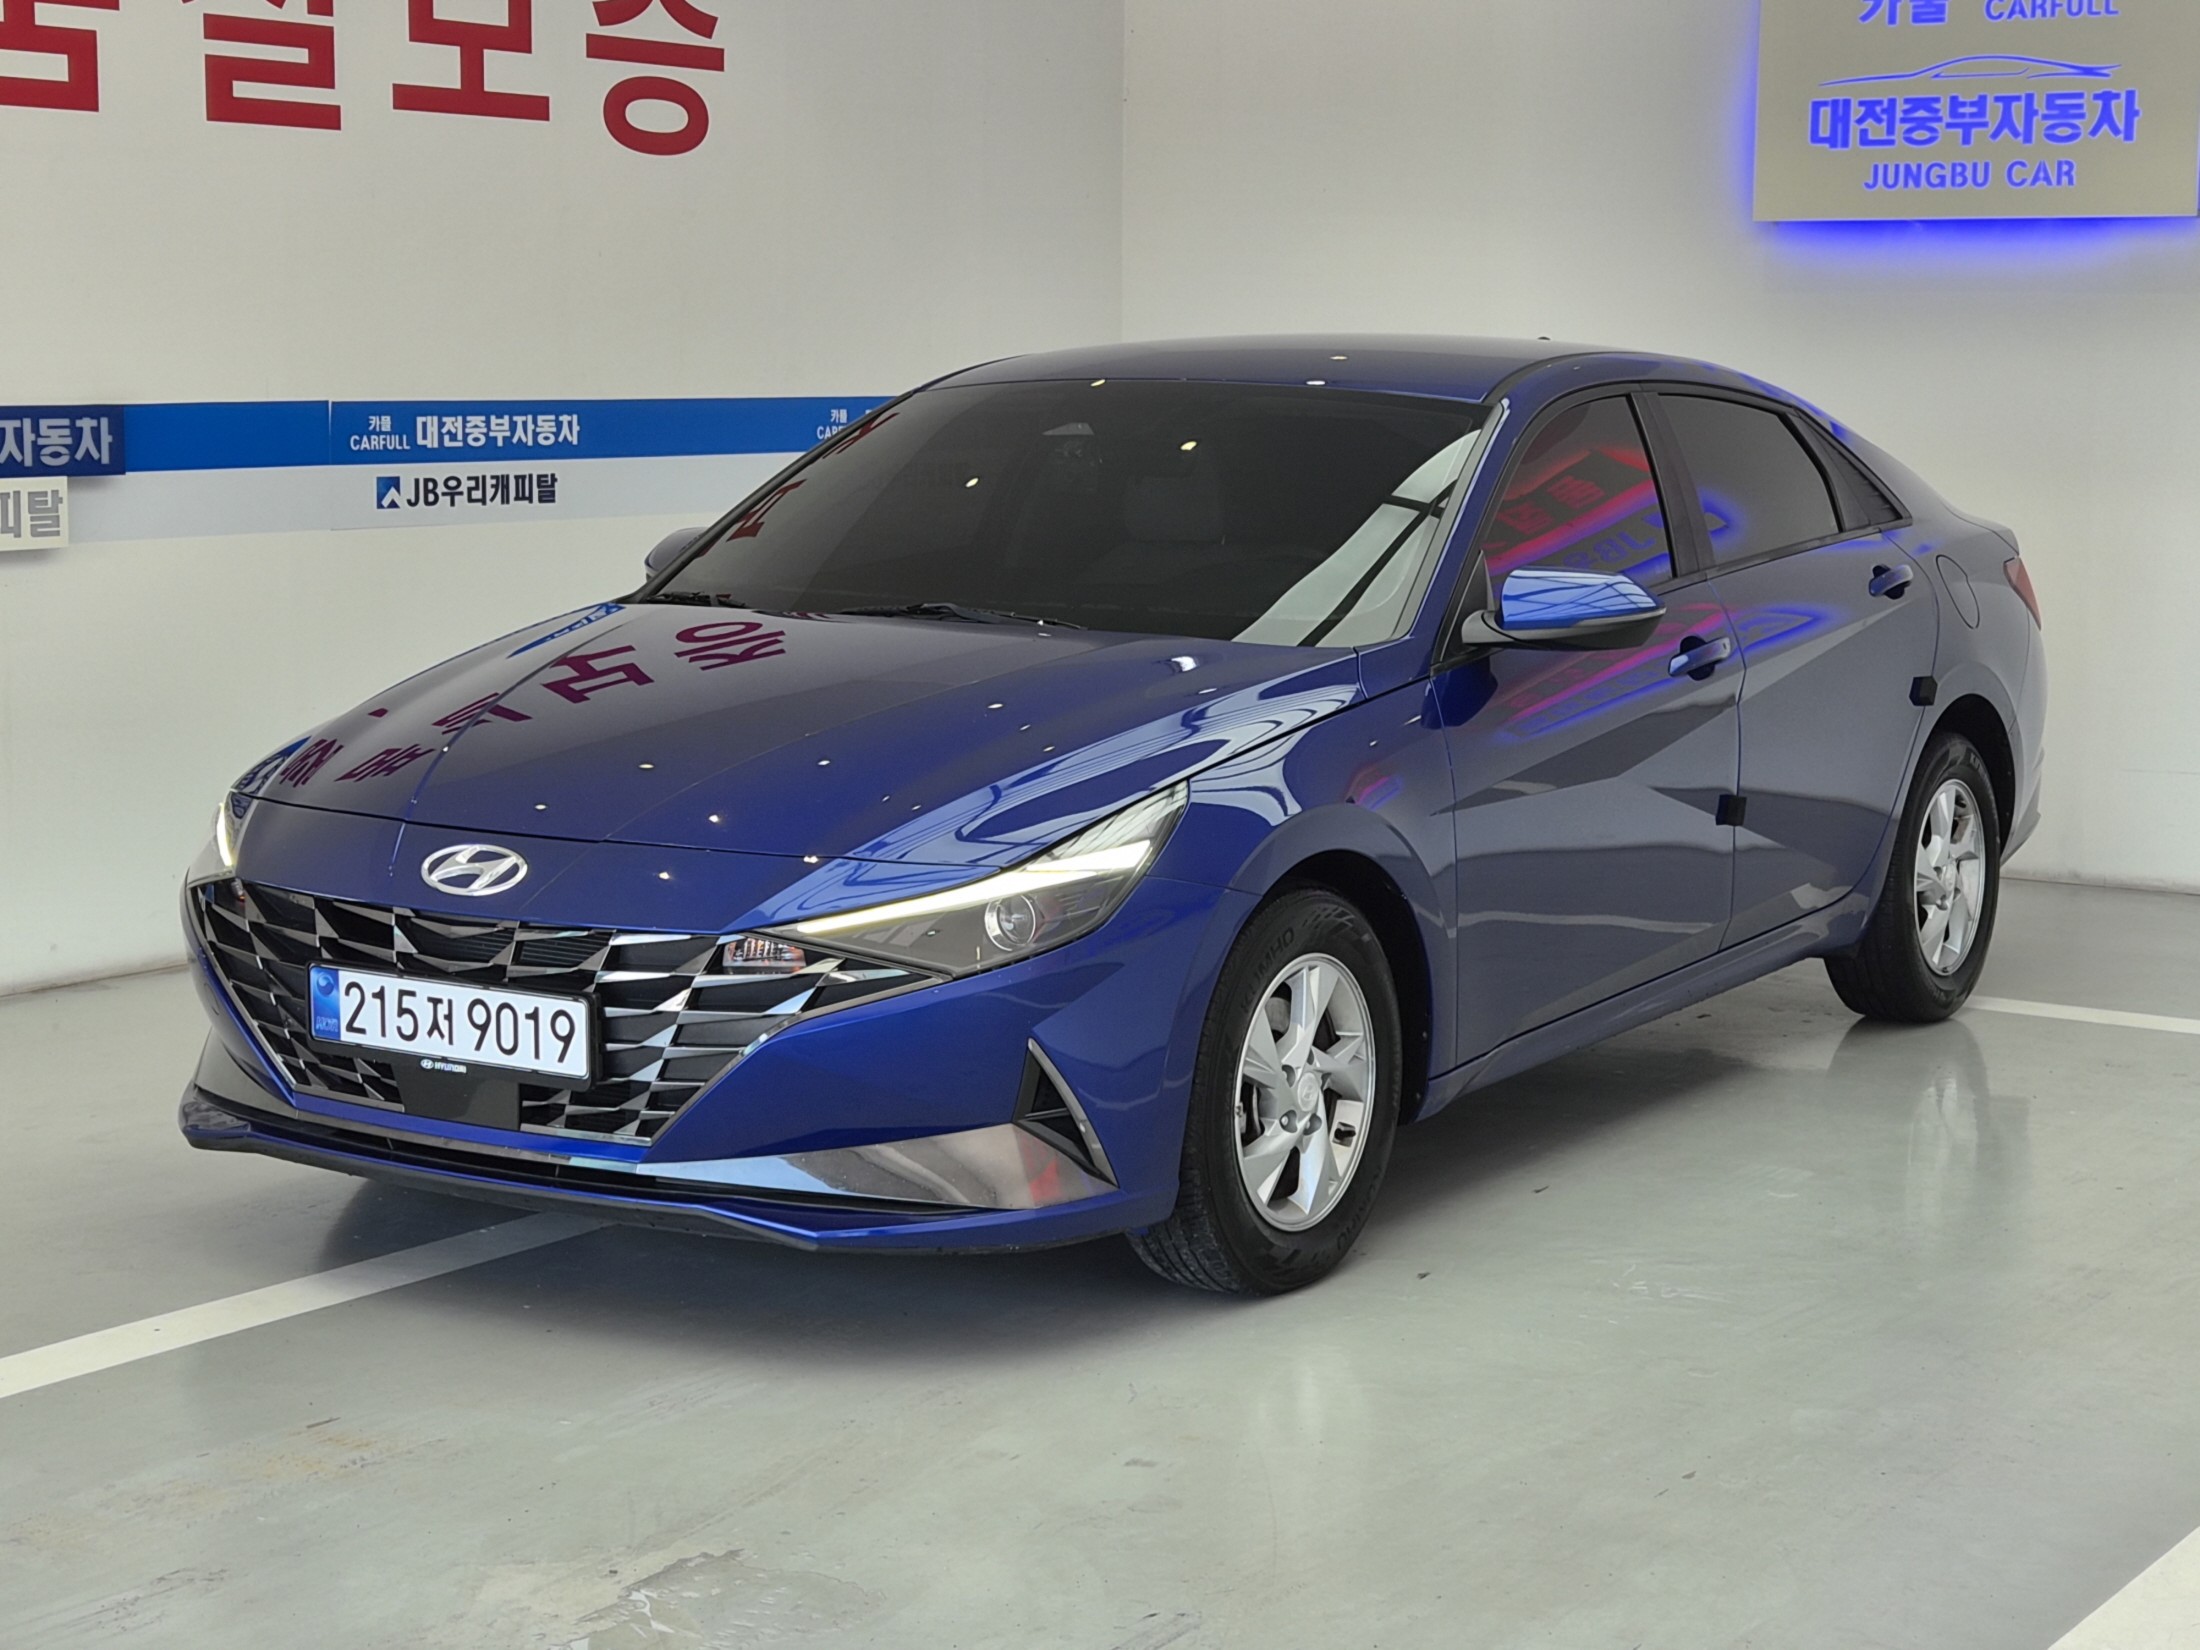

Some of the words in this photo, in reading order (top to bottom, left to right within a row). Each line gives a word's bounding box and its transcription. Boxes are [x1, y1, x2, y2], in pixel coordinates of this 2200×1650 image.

[1810, 89, 2140, 149] 대전중부자동차
[1864, 161, 1991, 190] JUNGBU
[2006, 159, 2076, 188] CAR
[0, 416, 113, 467] 자동차
[350, 434, 411, 450] CARFULL
[416, 414, 580, 448] 대전중부자동차
[406, 473, 558, 507] JB우리캐피탈
[467, 998, 576, 1063] 9019
